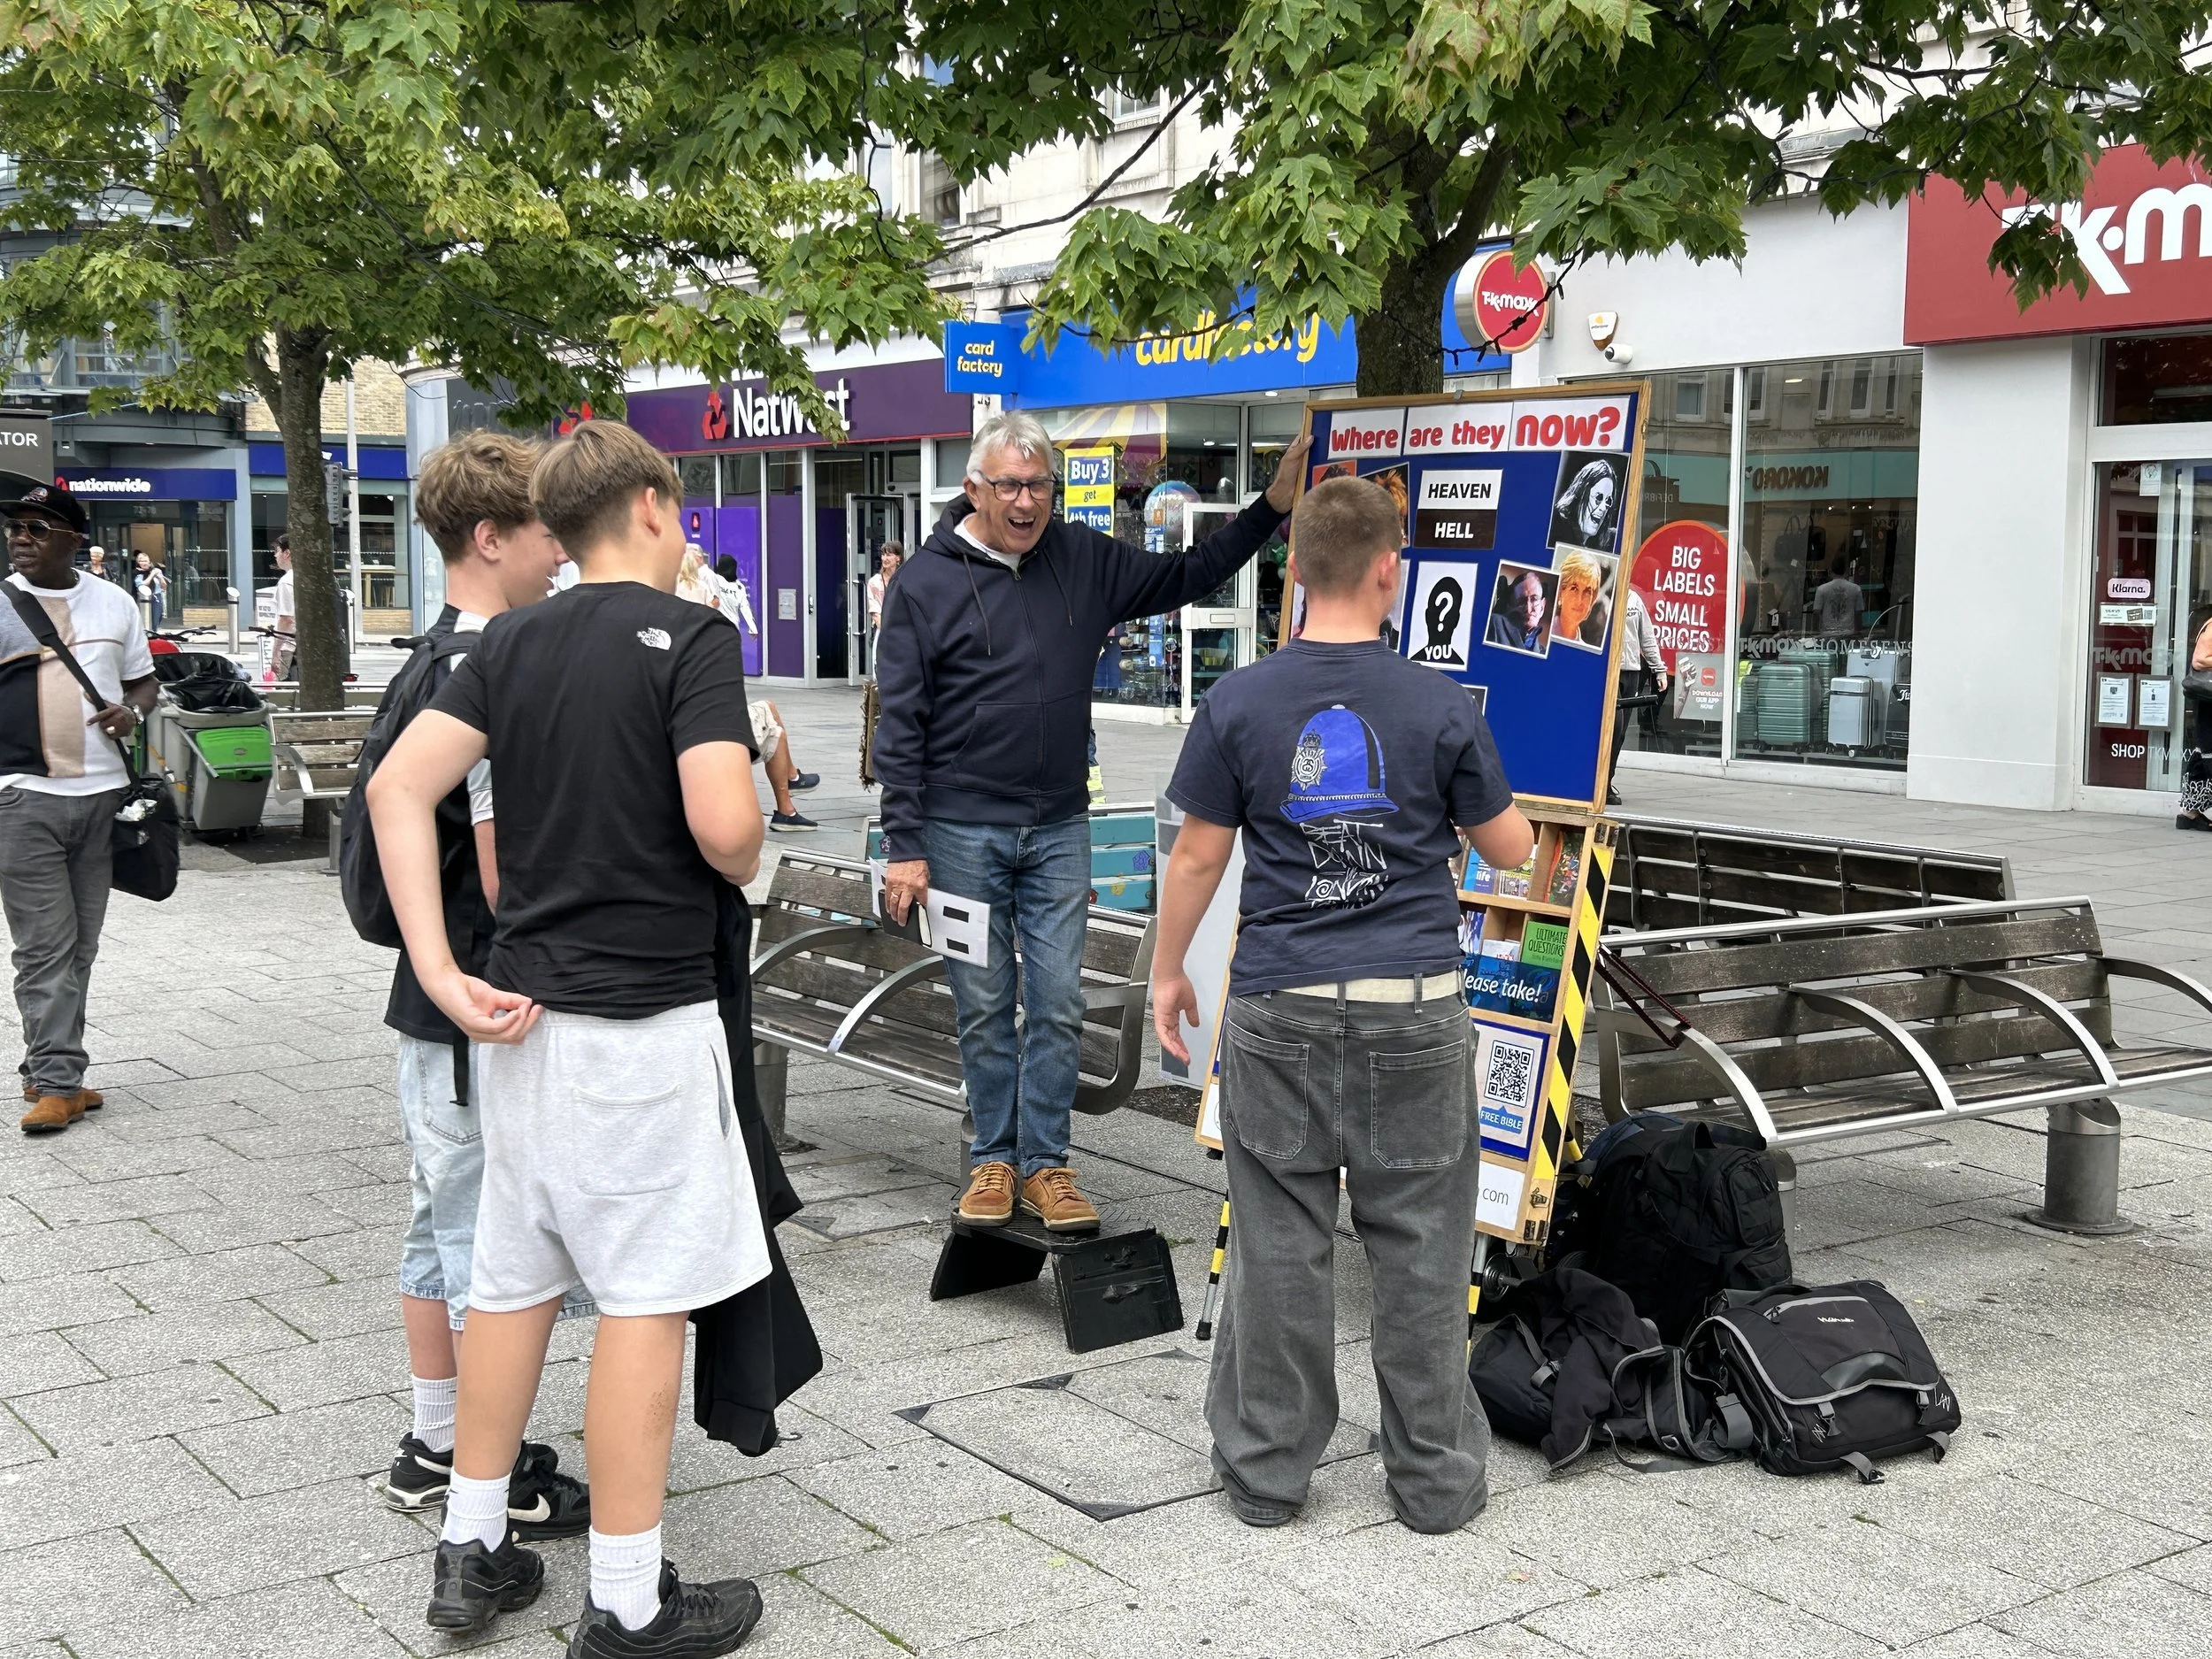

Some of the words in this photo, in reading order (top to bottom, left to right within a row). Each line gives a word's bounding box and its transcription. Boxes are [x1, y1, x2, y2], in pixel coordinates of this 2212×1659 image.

[964, 340, 995, 356] card
[957, 356, 1002, 378] factory
[733, 378, 850, 438] NatWst
[1332, 426, 1399, 452] Where
[1409, 426, 1443, 447] are
[1452, 420, 1505, 449] they
[1515, 406, 1621, 447] now?
[0, 431, 39, 447] TOR
[1071, 460, 1100, 485] Buy
[1101, 458, 1110, 479] 3
[69, 477, 151, 492] nationwide
[1428, 483, 1492, 499] HEAVEN
[1084, 490, 1096, 503] get
[1087, 511, 1111, 527] free
[1434, 522, 1474, 539] HELL
[1671, 545, 1701, 569] BIG
[1654, 569, 1716, 596] LABELS
[2111, 583, 2146, 594] Klarna.
[1654, 599, 1709, 626] SMALL
[1652, 625, 1710, 653] PRICES
[1425, 643, 1454, 660] YOU
[2111, 744, 2145, 758] SHOP
[1476, 870, 1491, 882] life
[1536, 927, 1568, 944] ULTIMATE
[1464, 968, 1499, 994] lease
[1502, 978, 1542, 1002] take!
[1480, 1110, 1500, 1124] FREE
[1500, 1116, 1523, 1130] BIBLE
[1482, 1187, 1509, 1205] com
